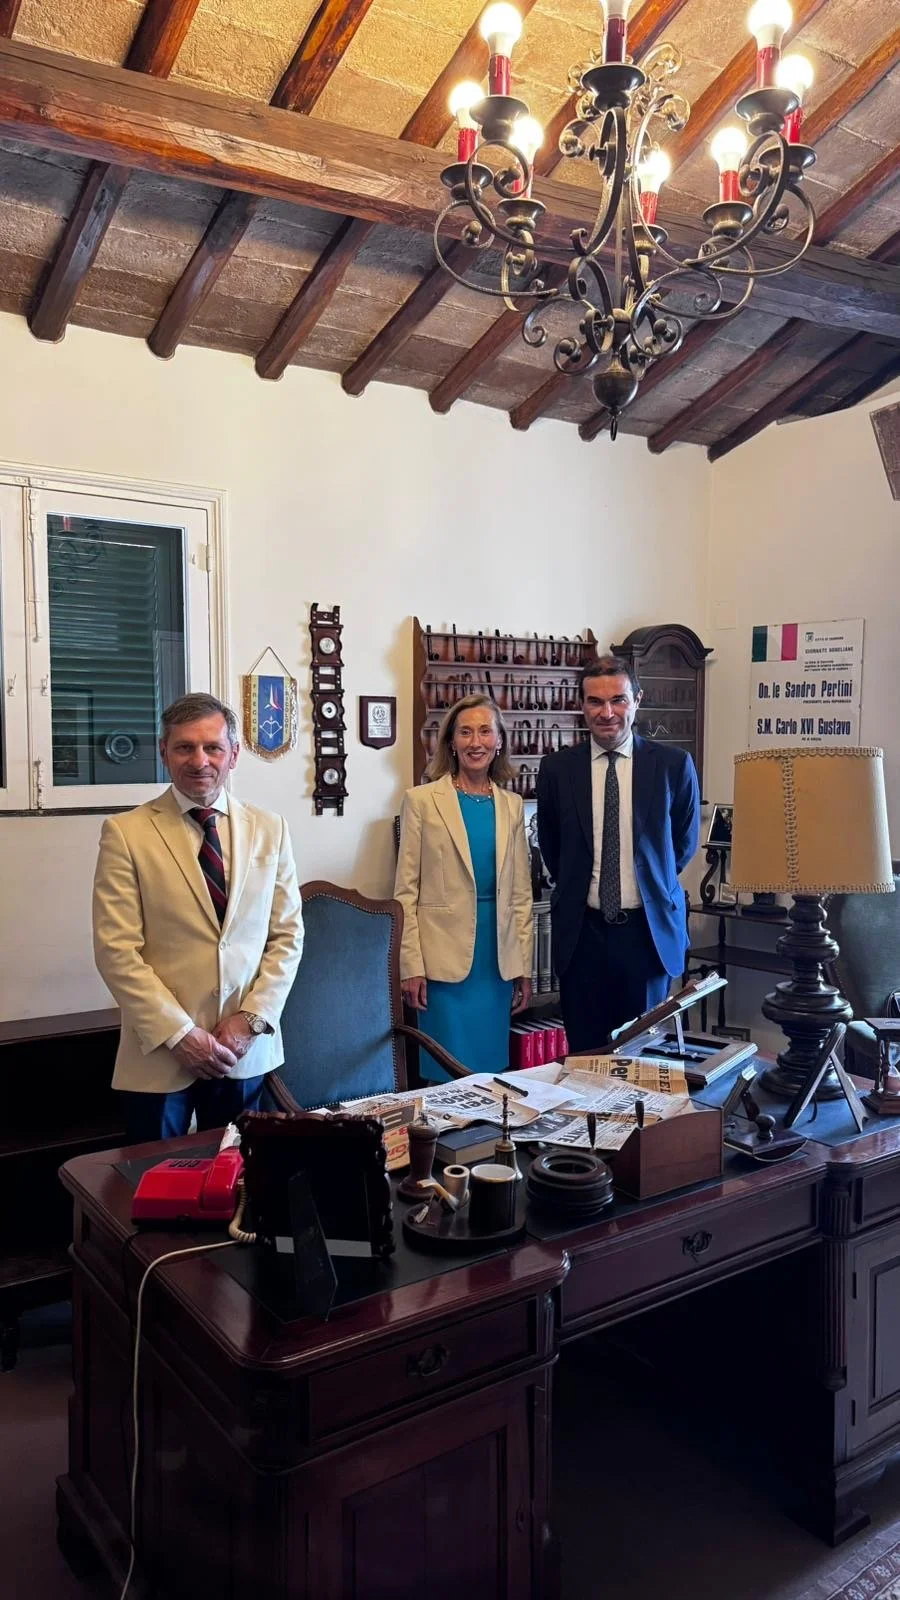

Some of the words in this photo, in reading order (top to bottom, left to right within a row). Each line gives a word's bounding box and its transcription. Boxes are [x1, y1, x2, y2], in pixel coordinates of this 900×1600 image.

[785, 681, 816, 698] Sandro
[821, 680, 853, 698] Pertini
[757, 718, 773, 735] S.M.
[776, 718, 797, 735] Carlo
[800, 718, 814, 734] XVI
[818, 718, 851, 736] Gustavo
